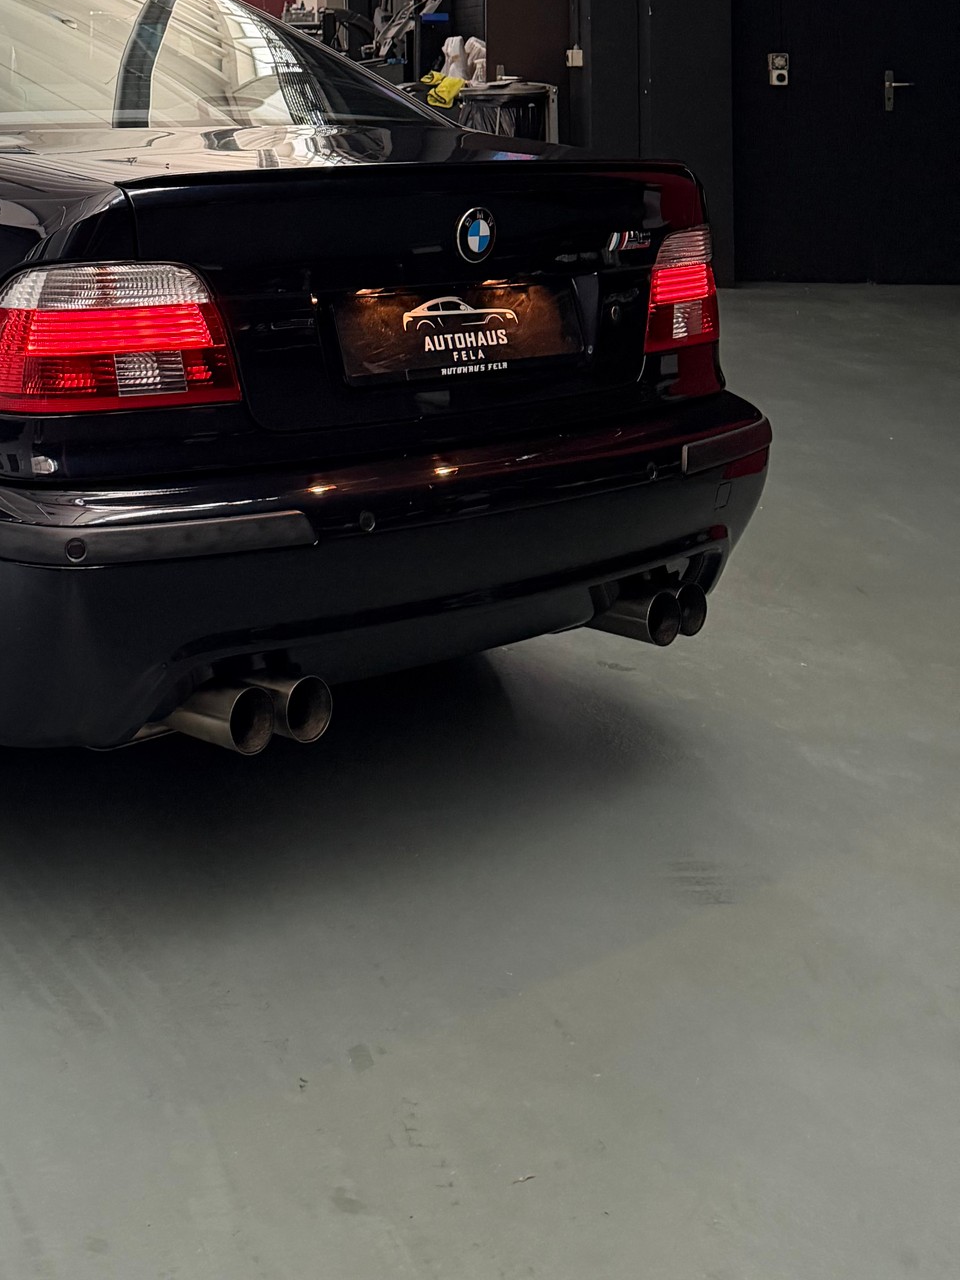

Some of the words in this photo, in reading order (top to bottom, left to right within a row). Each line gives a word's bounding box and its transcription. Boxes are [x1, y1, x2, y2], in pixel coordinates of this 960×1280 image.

[424, 329, 508, 352] AUTOHAUS
[453, 349, 486, 362] FELA
[441, 364, 486, 376] AUTOHAUS
[487, 362, 508, 371] FELA
